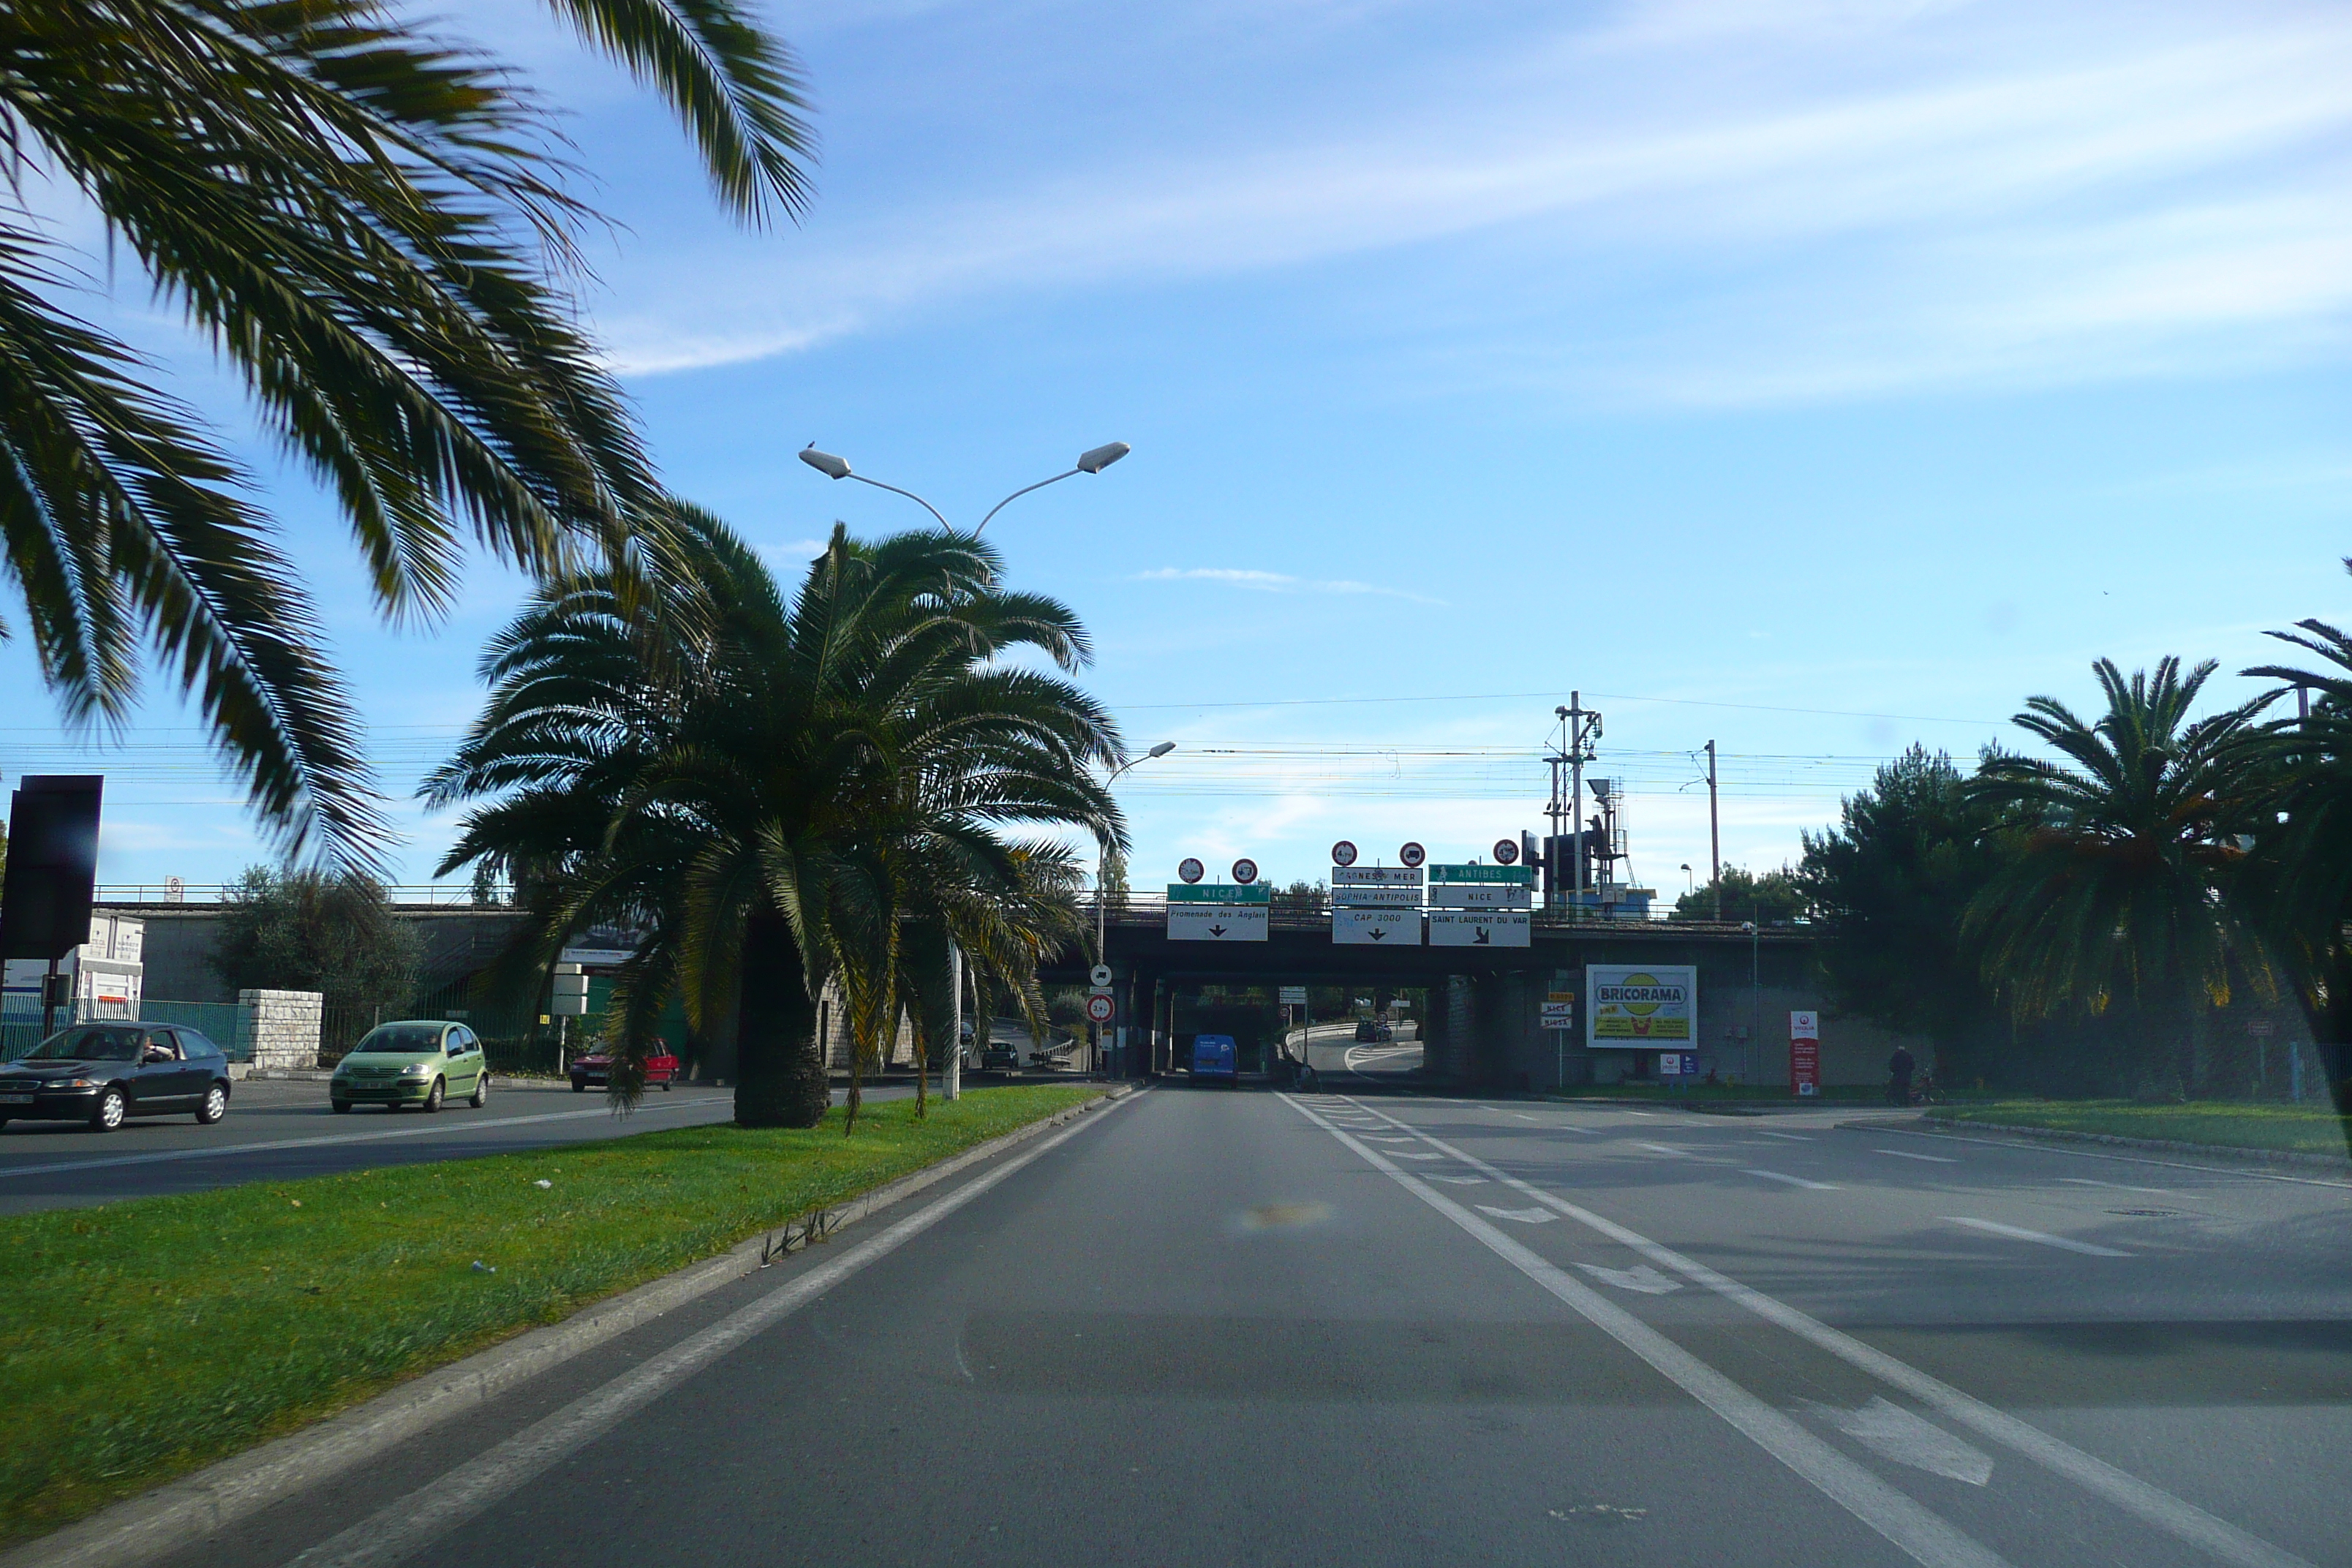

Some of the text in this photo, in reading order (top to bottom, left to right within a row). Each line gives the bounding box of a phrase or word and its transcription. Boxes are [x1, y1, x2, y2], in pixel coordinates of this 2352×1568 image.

[1458, 870, 1501, 878] ANTIBES
[1202, 889, 1235, 898] NICE
[1468, 893, 1492, 901] NICE
[1170, 910, 1266, 920] Promenade des Anglais
[1354, 913, 1401, 922] CAP 3000
[1458, 916, 1493, 924] LAURENT
[1600, 987, 1681, 1002] BRICORAMA
